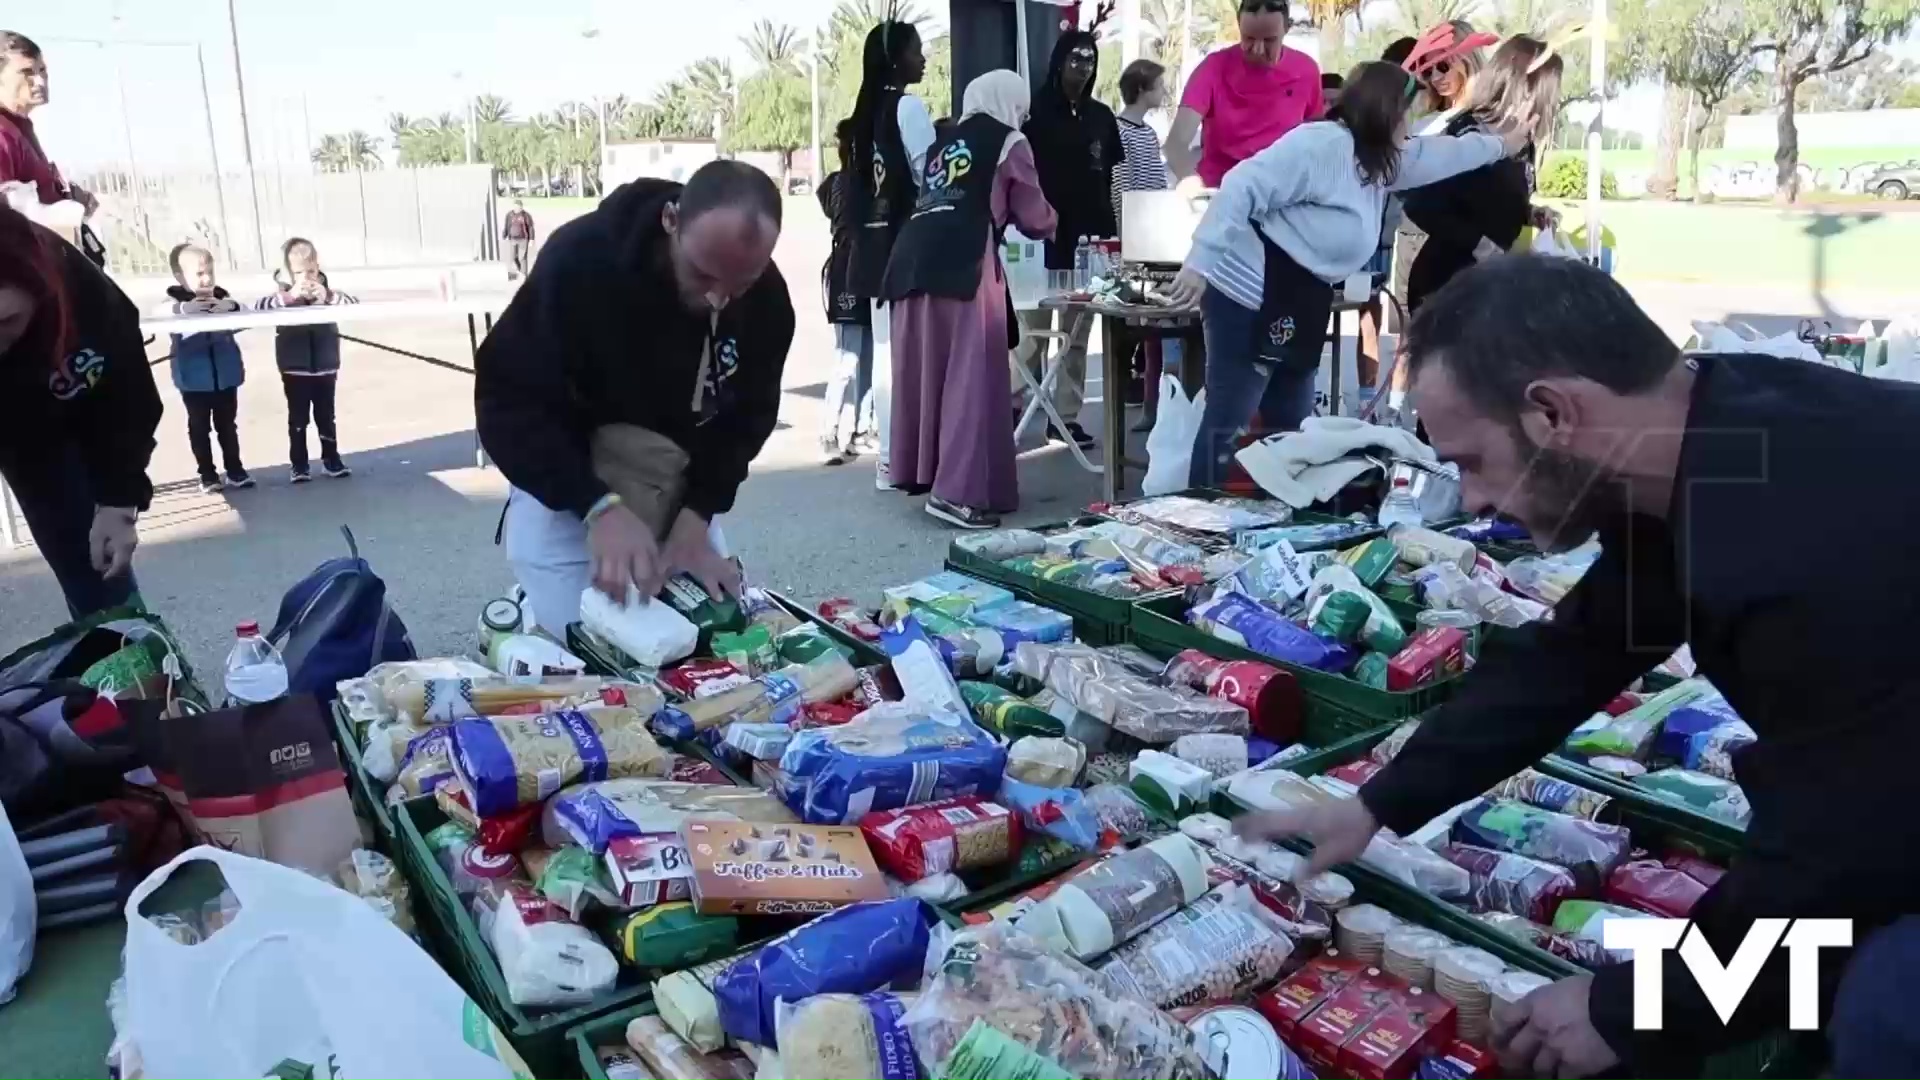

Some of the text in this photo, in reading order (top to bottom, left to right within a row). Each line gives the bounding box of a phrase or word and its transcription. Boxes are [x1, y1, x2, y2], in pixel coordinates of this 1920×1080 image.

[713, 861, 863, 881] Toffee & Nuts
